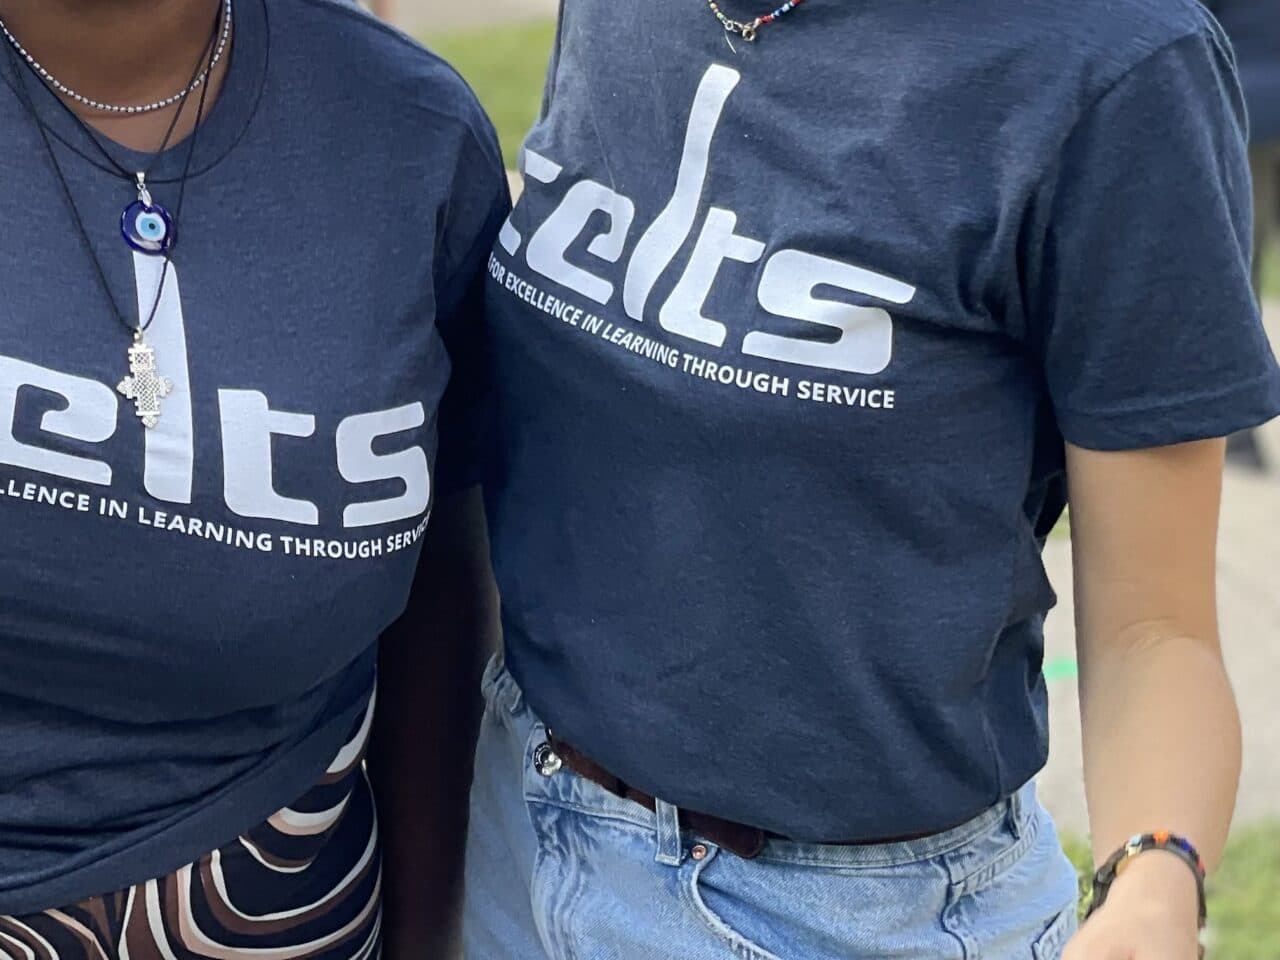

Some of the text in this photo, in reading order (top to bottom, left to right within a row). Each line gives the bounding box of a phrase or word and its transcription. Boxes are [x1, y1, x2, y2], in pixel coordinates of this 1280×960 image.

[489, 257, 506, 284] FOR
[505, 272, 585, 326] EXCELLENCE
[580, 313, 605, 335] IN
[602, 323, 680, 368] LEARNING
[682, 354, 790, 397] THROUGH
[796, 380, 896, 409] SERVICE
[99, 497, 128, 519] IN
[138, 506, 273, 552] LEARNING
[279, 535, 382, 559] THROUGH
